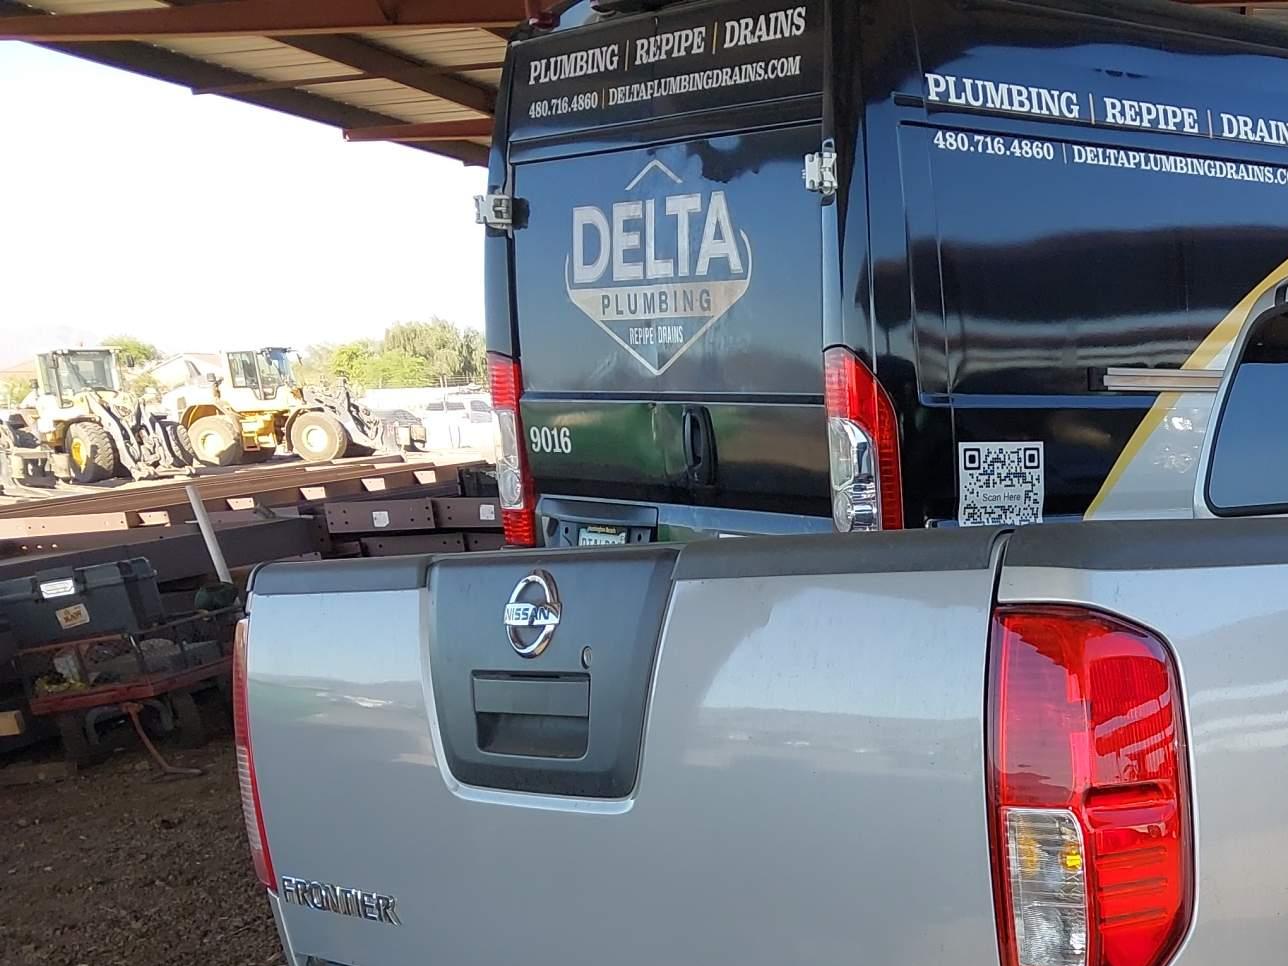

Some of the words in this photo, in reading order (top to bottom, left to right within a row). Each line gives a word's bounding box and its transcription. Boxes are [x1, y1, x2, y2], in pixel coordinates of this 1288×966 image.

[528, 44, 619, 85] PLUMBING
[634, 26, 706, 66] REPIPE
[723, 7, 807, 49] DRAINS
[528, 91, 599, 119] 480.716.4860
[924, 72, 1080, 118] PLUMBING
[1103, 96, 1198, 134] REPIPE
[933, 130, 1054, 161] 480.716.4860
[572, 190, 744, 284] DELTA
[601, 288, 713, 316] PLUMBING
[629, 327, 654, 345] REPIPE
[657, 325, 683, 344] DRAINS
[530, 426, 572, 454] 9016
[982, 493, 1001, 501] Scan
[1003, 491, 1021, 501] Here
[505, 606, 551, 621] NISSAN
[282, 875, 402, 927] FRONTIER
